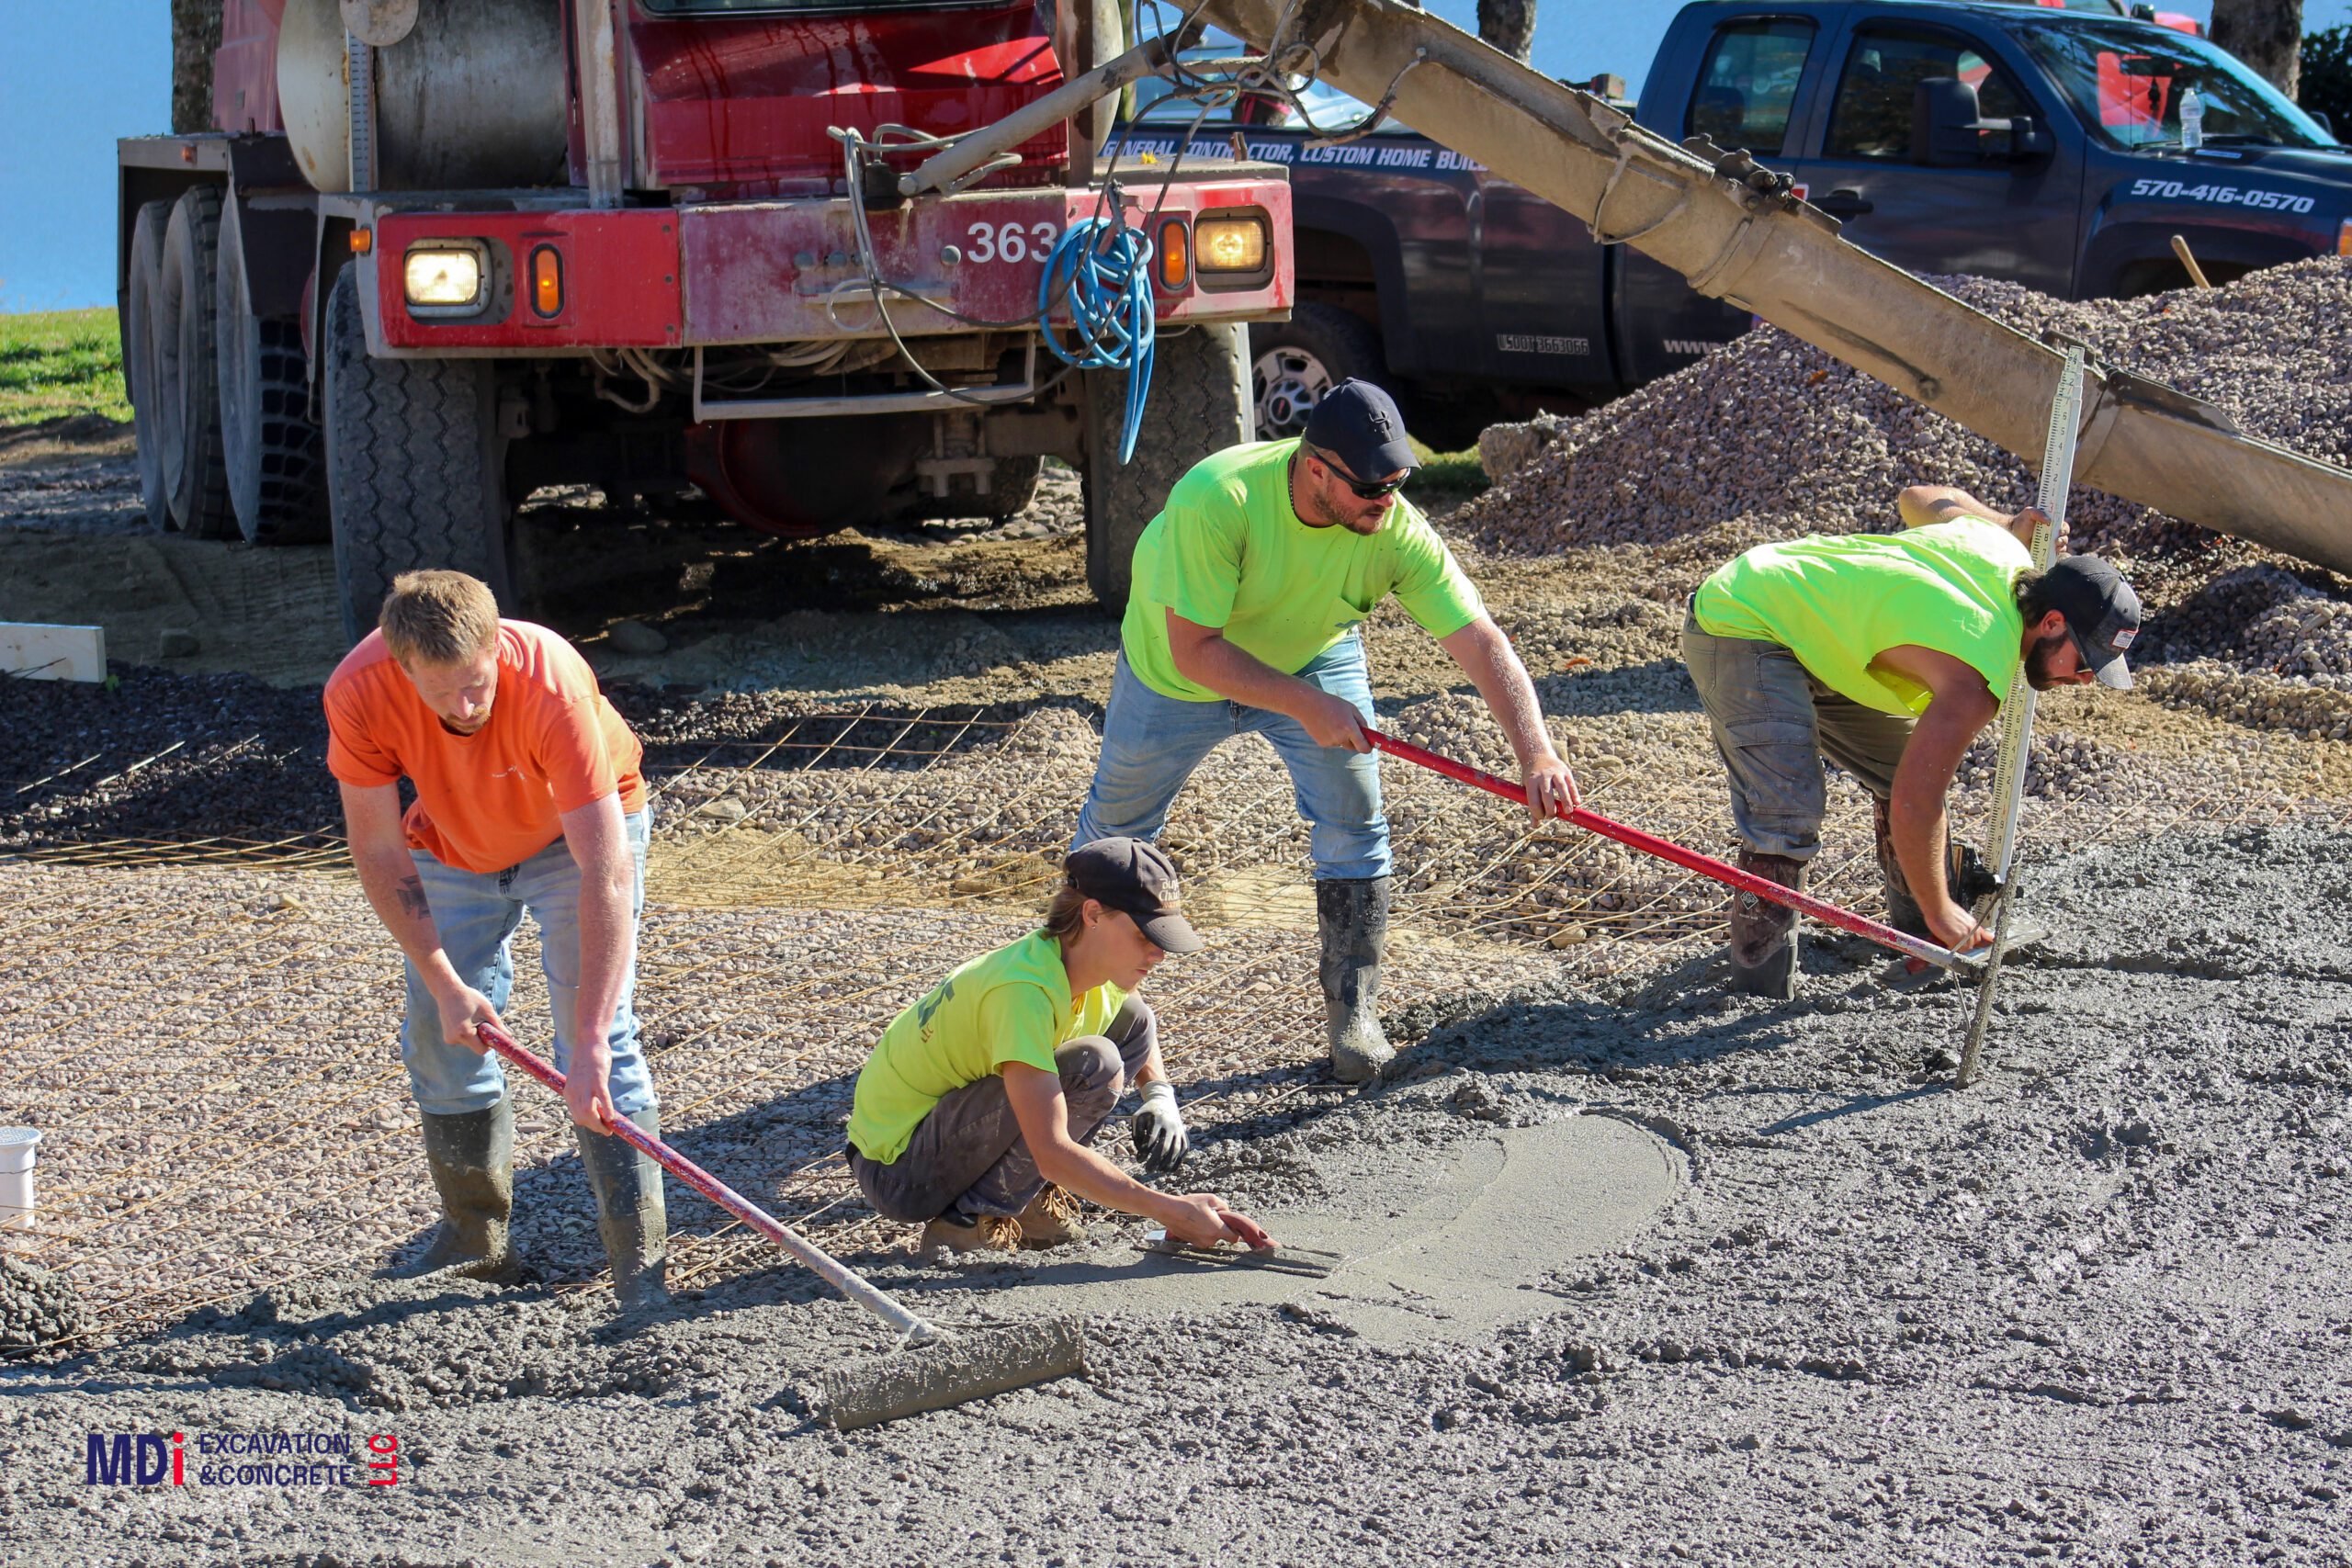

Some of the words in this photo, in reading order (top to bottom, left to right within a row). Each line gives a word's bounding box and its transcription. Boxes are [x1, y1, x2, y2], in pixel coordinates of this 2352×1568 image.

[1103, 141, 1177, 156] GNERAL
[1300, 146, 1375, 164] CUSTOM
[1376, 148, 1431, 167] HOME
[1435, 150, 1488, 172] BUIL
[2132, 179, 2314, 213] 570-416-0570
[967, 222, 1057, 263] 363
